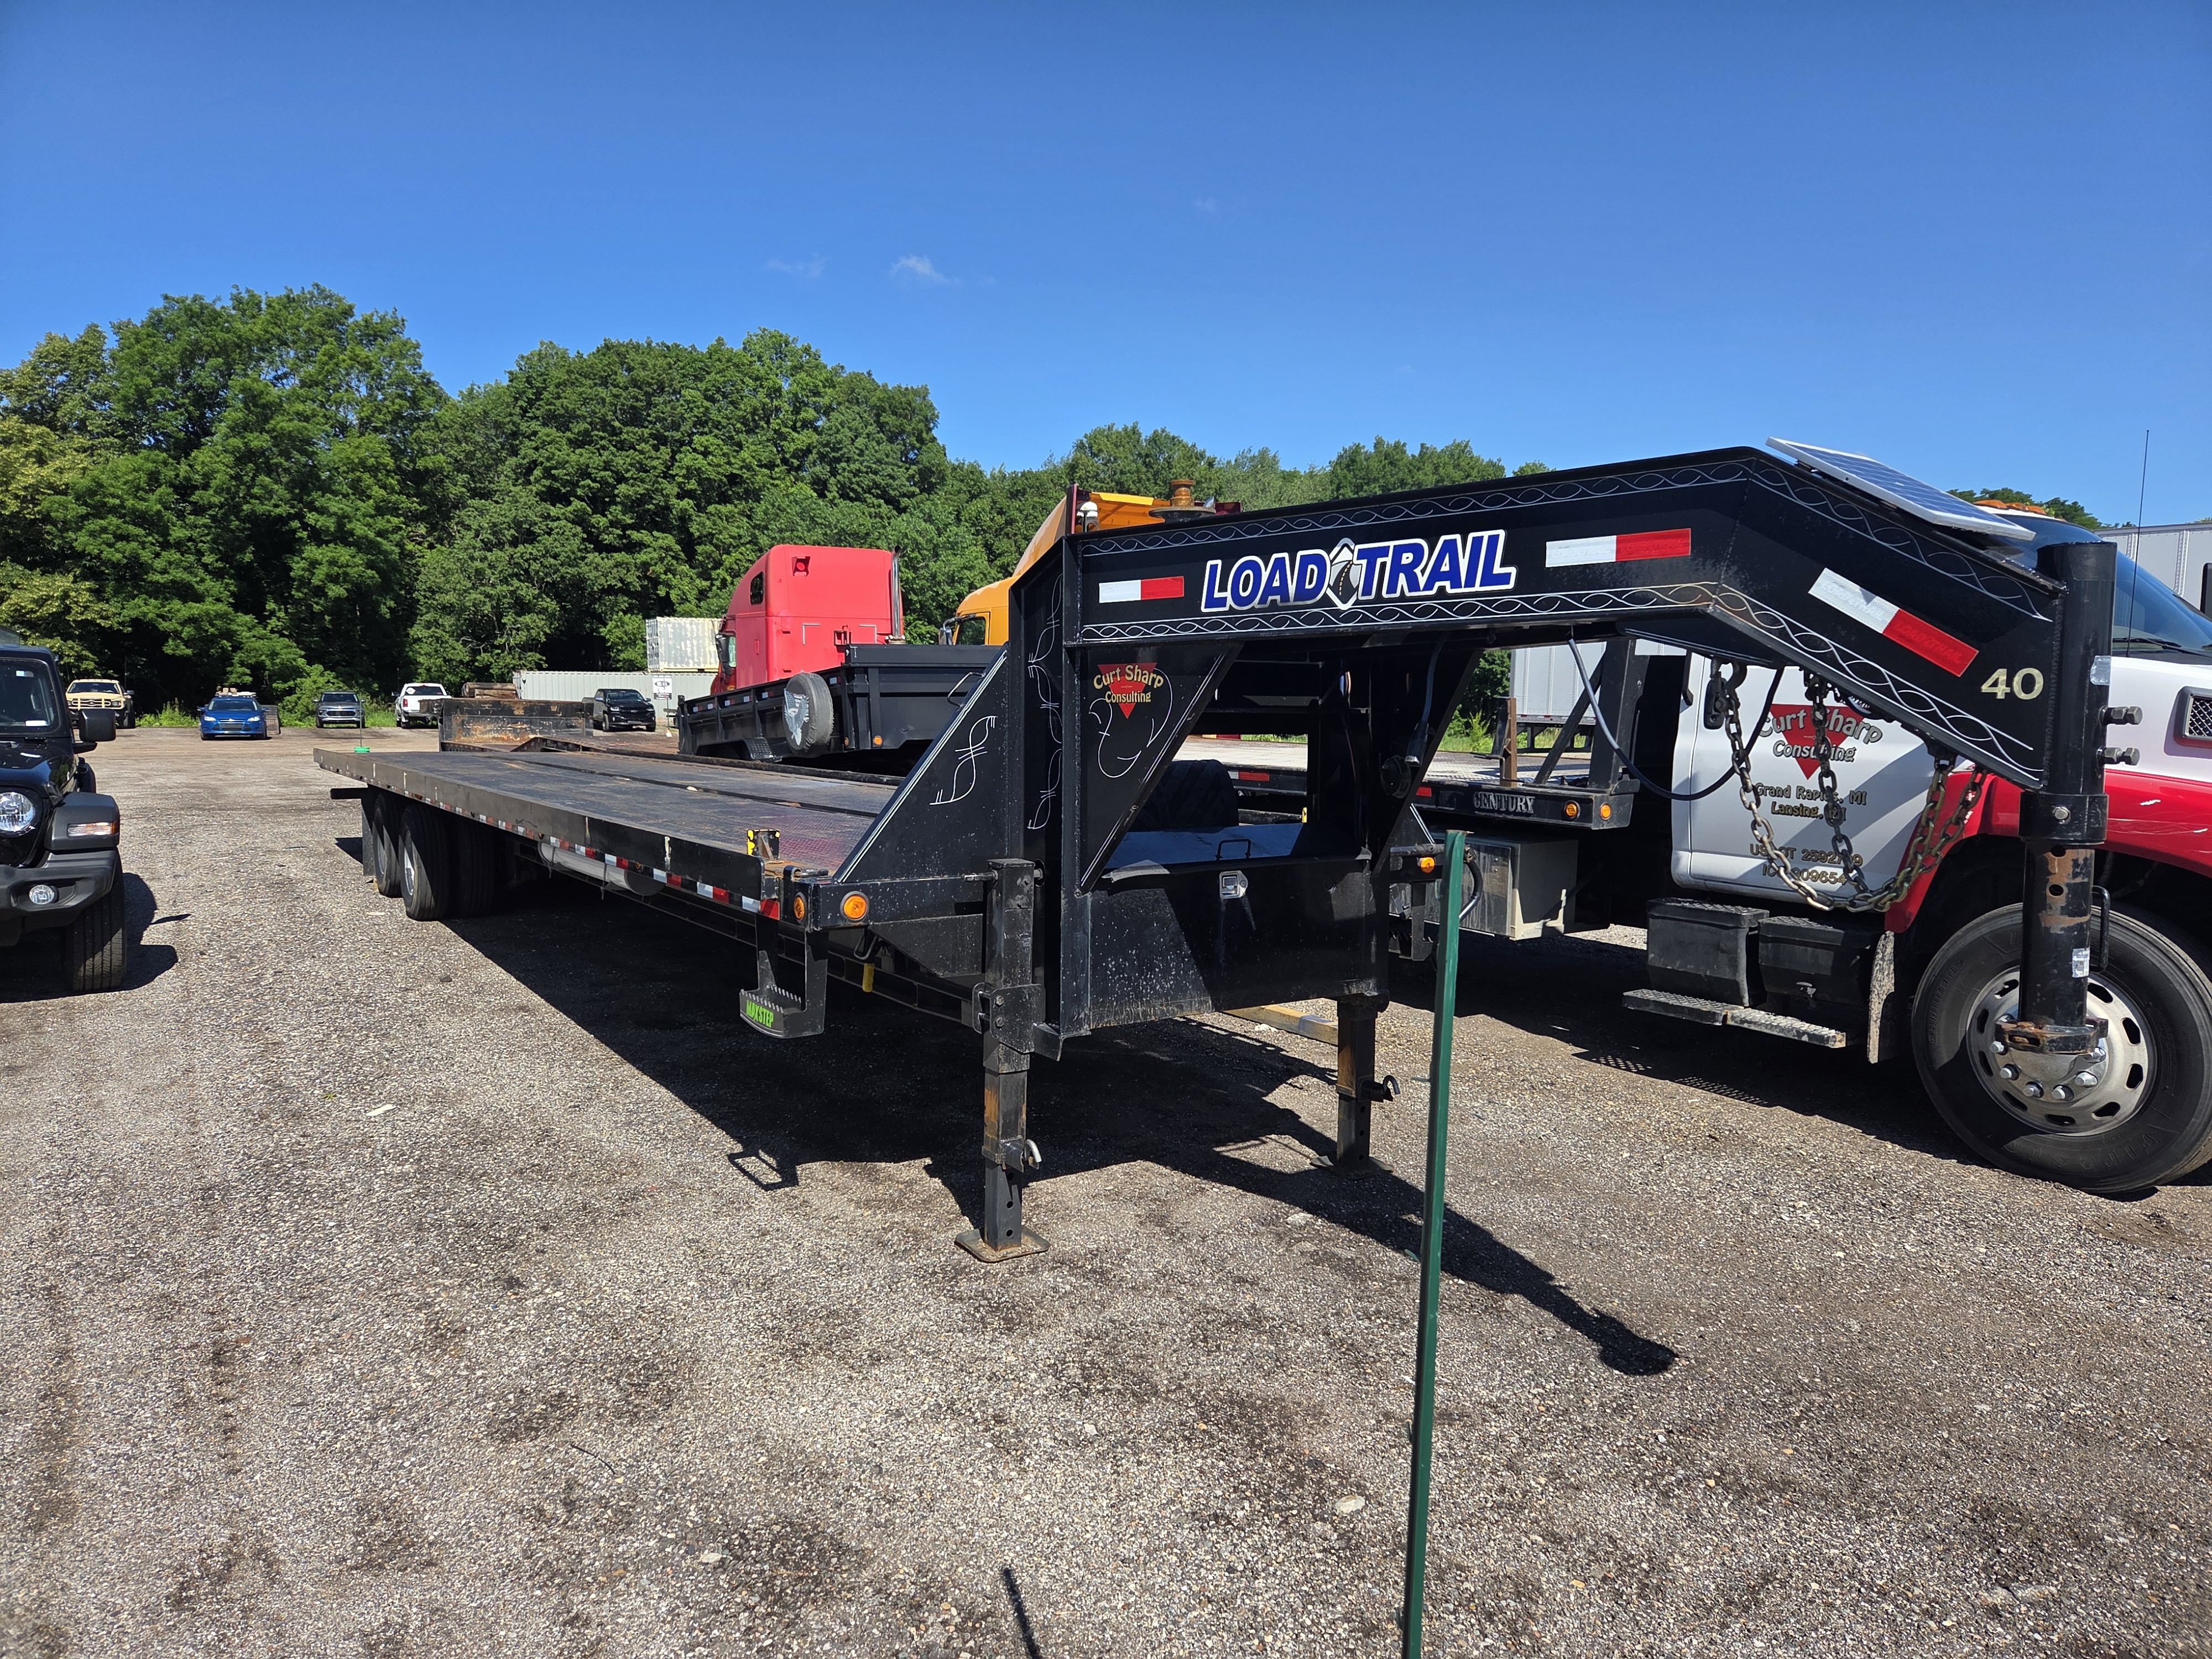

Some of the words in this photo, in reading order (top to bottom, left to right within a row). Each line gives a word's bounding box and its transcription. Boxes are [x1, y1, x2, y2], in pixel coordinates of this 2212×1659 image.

[1201, 549, 1330, 613] LOAD
[1352, 529, 1517, 601] TRAIL
[1093, 667, 1121, 689] Curt
[1125, 665, 1164, 688] Sharp
[1980, 667, 2044, 700] 40
[1105, 691, 1151, 703] Consulting
[1473, 791, 1536, 814] CENTURY
[1755, 782, 1791, 798] Grand
[1849, 790, 1867, 805] MI
[1771, 801, 1824, 820] Lansing,
[1750, 843, 1797, 859] USOT
[747, 999, 774, 1028] MAXSTEP
